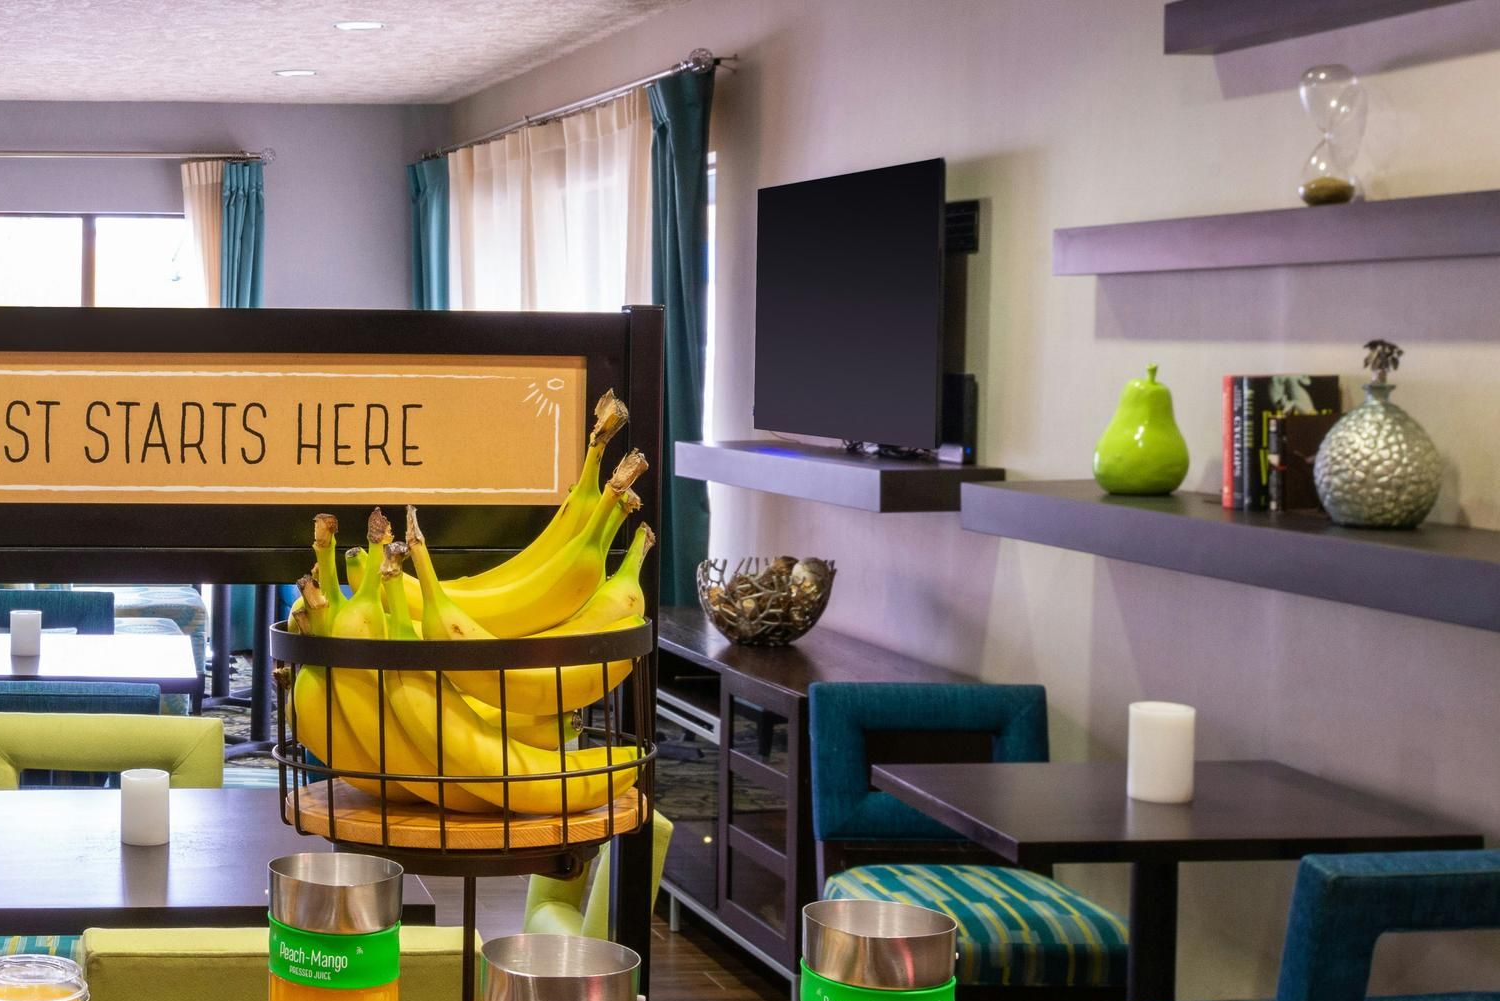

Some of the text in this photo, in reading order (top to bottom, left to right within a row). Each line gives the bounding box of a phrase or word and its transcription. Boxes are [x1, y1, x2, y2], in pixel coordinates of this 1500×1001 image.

[84, 401, 268, 465] STARTS
[296, 402, 424, 466] HERE
[279, 941, 349, 973] Peach-Mango
[288, 964, 332, 981] PRESSED JUICE
